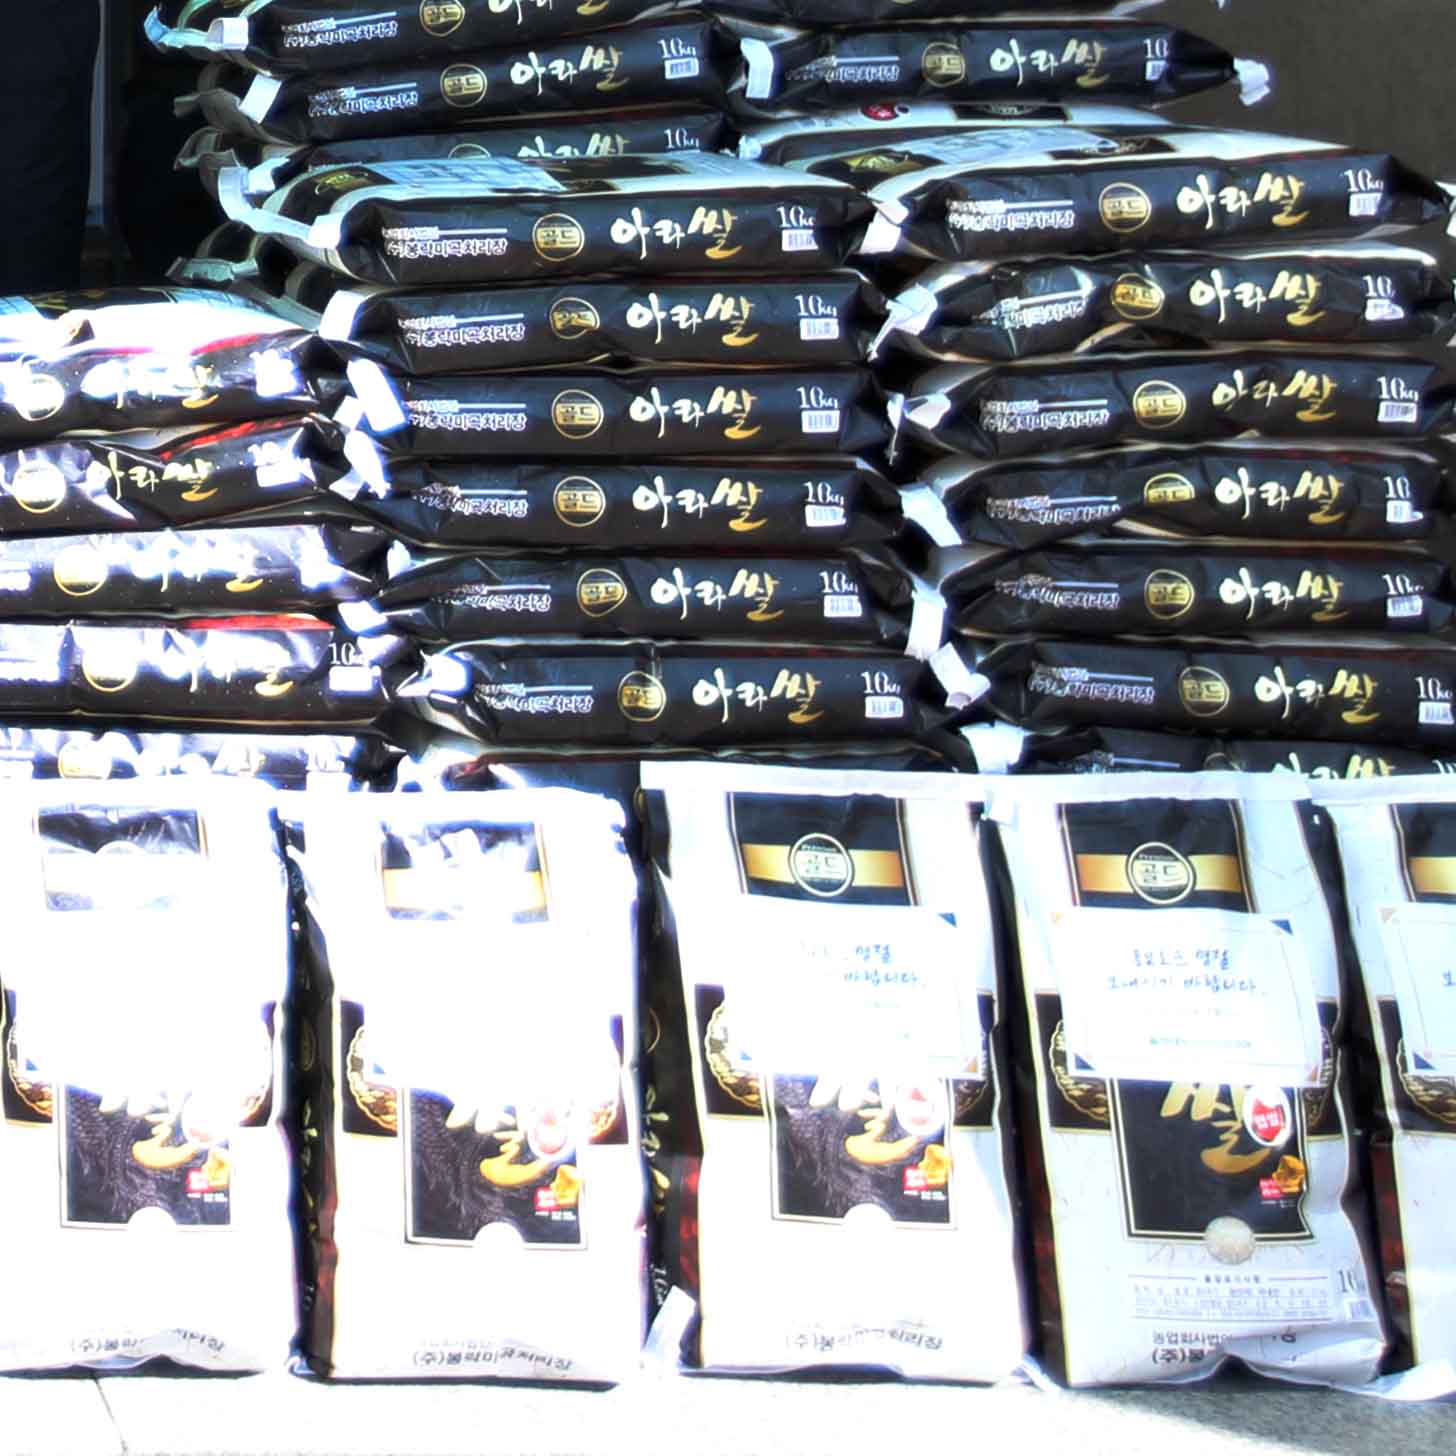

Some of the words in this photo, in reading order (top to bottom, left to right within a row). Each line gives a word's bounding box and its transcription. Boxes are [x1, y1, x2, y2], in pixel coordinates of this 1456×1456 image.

[510, 47, 629, 94] 아라쌀
[990, 38, 1107, 87] 아라쌀
[1177, 173, 1306, 227] 아라쌀
[610, 206, 744, 259] 아라쌀
[626, 293, 760, 347] 아라쌀
[1189, 269, 1325, 327] 아라쌀
[629, 387, 762, 439] 아라쌀
[1211, 370, 1337, 422] 아라쌀
[632, 474, 768, 533] 아라쌀
[1215, 468, 1345, 526] 아라쌀
[650, 567, 785, 622] 아라쌀
[1218, 568, 1350, 623] 아라쌀
[692, 669, 822, 724] 아라쌀
[1255, 666, 1380, 725] 아라쌀
[1138, 861, 1185, 885] 골드
